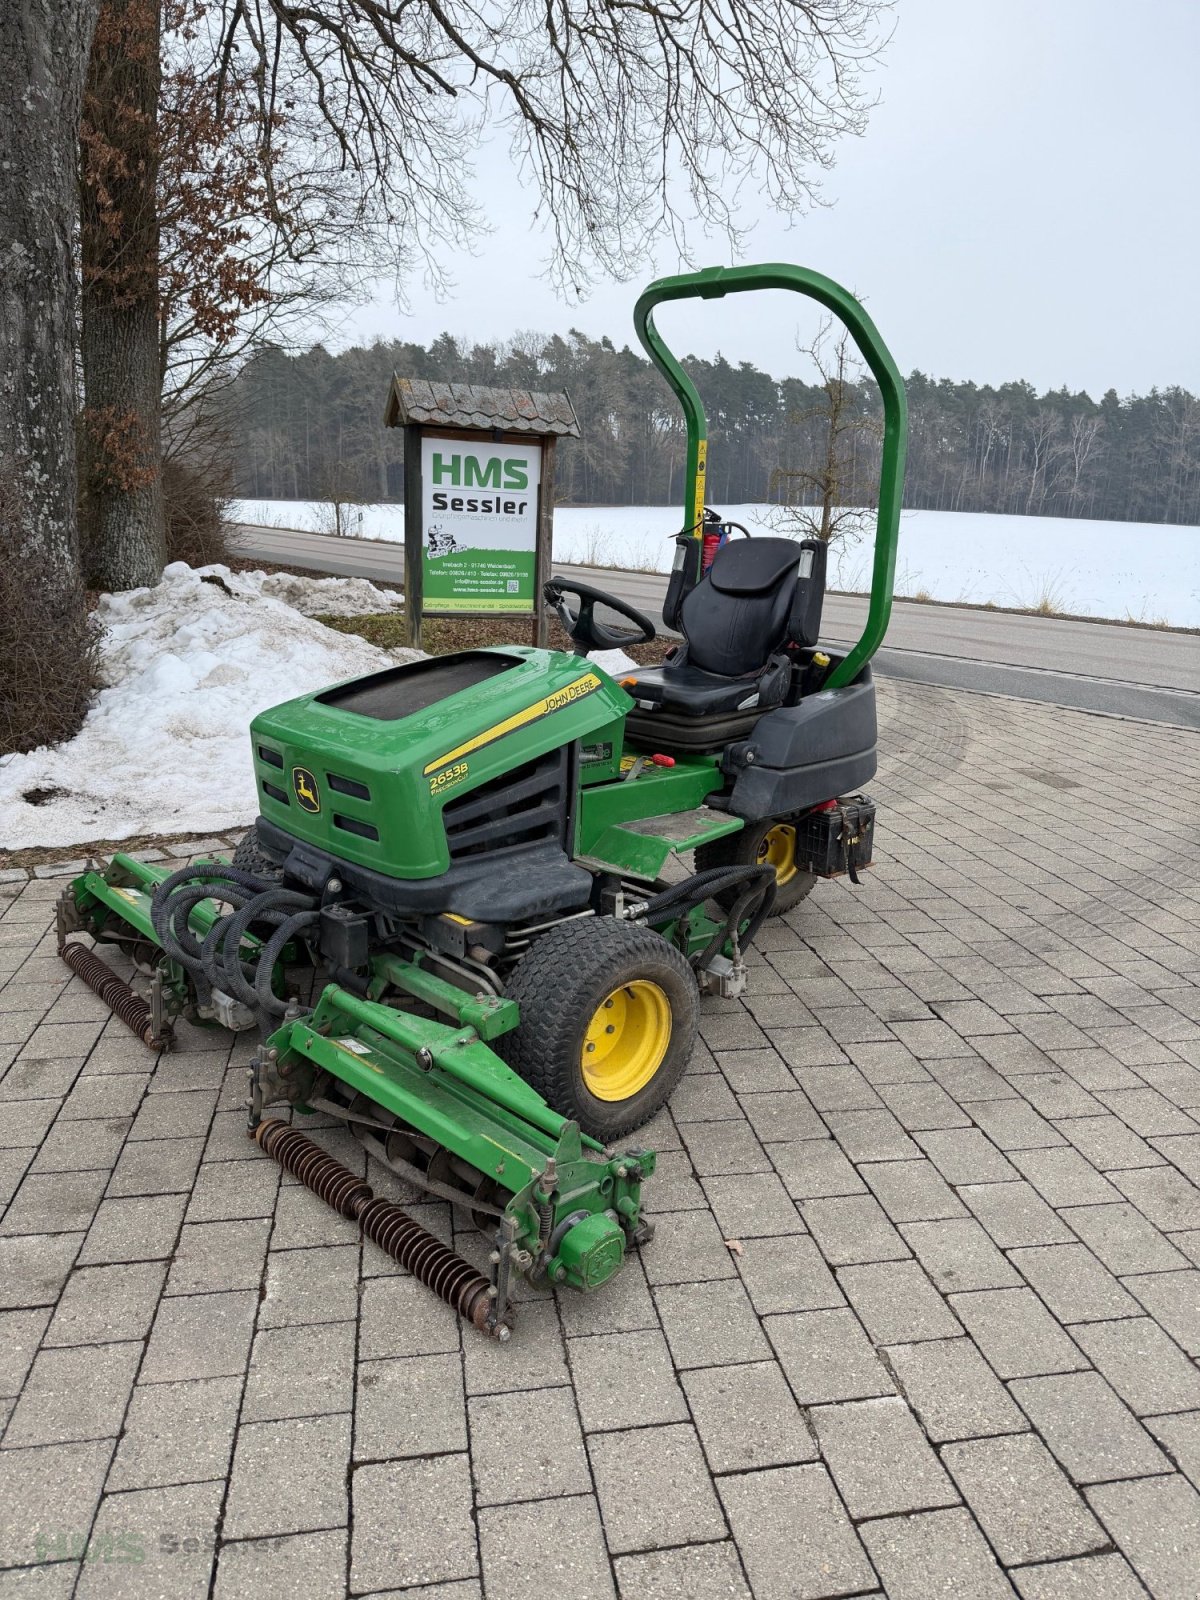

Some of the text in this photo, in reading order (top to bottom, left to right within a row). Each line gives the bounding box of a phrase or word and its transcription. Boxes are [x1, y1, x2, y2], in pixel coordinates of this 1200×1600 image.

[432, 453, 528, 489] HMS
[432, 493, 528, 514] Sessler
[544, 679, 595, 713] JOHN DEERE
[429, 762, 469, 789] 2653B
